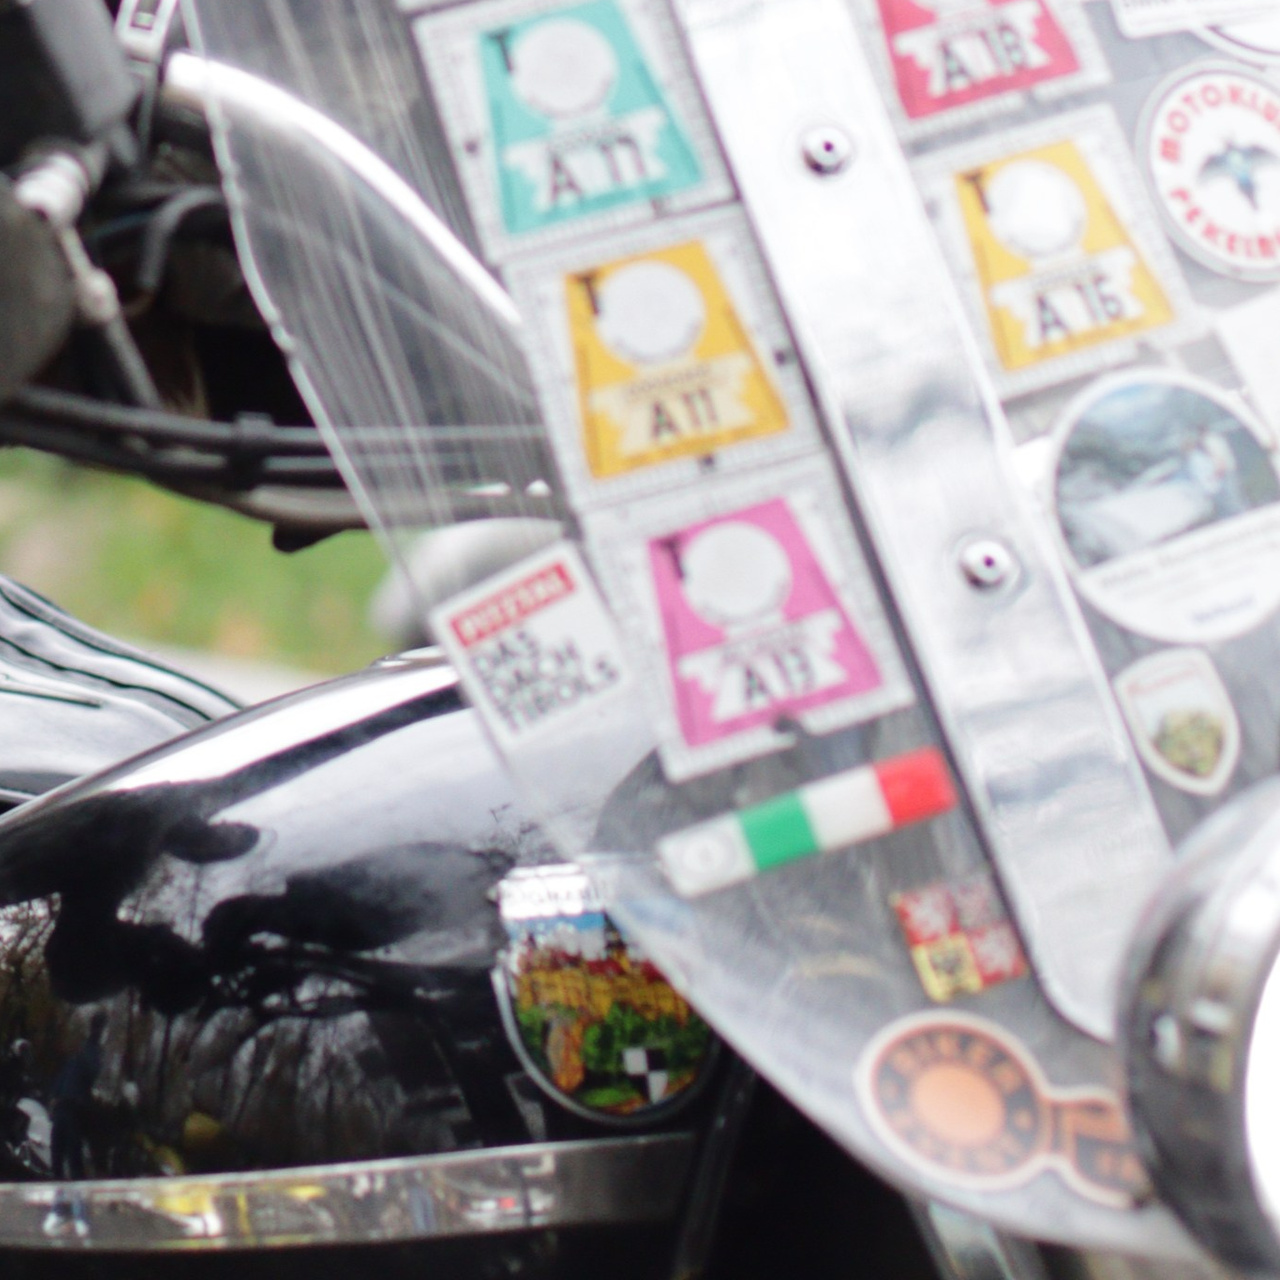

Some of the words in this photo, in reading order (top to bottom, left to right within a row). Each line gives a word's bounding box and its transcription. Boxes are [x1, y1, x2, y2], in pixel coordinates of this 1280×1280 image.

[941, 37, 971, 88] A
[1159, 82, 1280, 163] MOTOKLU
[549, 148, 584, 207] A
[1035, 292, 1066, 340] A
[650, 400, 685, 440] A
[743, 662, 776, 704] A
